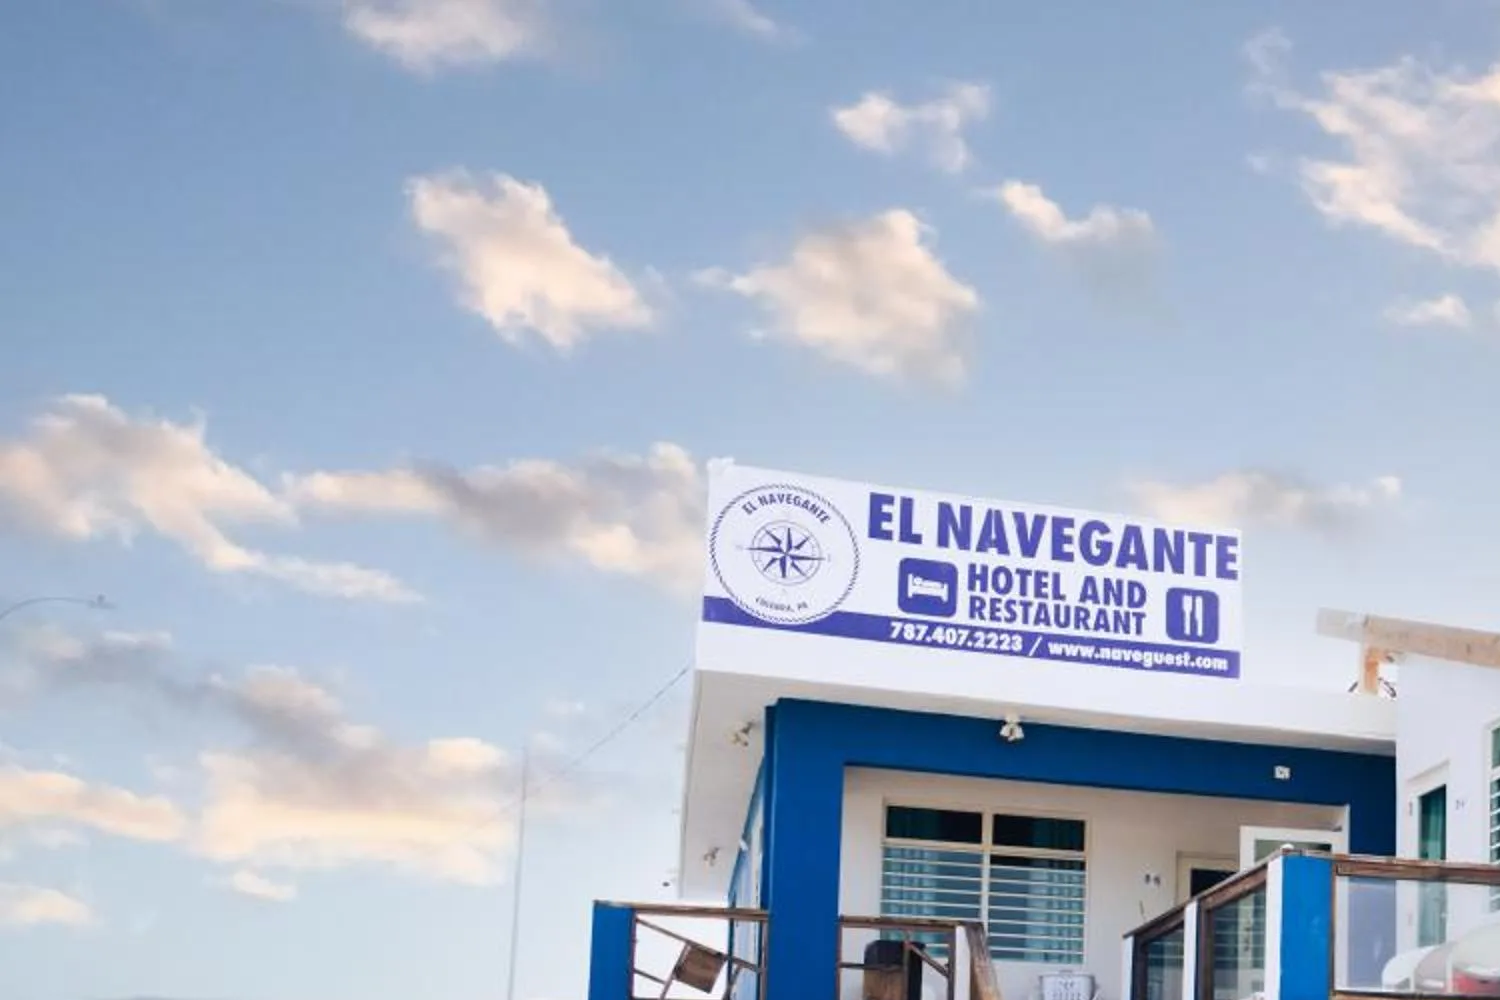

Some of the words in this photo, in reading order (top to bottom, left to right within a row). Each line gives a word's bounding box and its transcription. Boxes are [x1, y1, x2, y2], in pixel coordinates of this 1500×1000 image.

[742, 501, 757, 515] EL
[758, 493, 831, 524] NAVEGANTE
[868, 492, 923, 545] EL
[937, 502, 1240, 581] NAVEGANTE
[967, 563, 1067, 601] HOTEL
[1079, 575, 1147, 609] AND
[967, 598, 1147, 636] RESTAURANT
[890, 621, 1023, 651] 787.407.2223
[1048, 641, 1229, 671] www.naveguest.com
